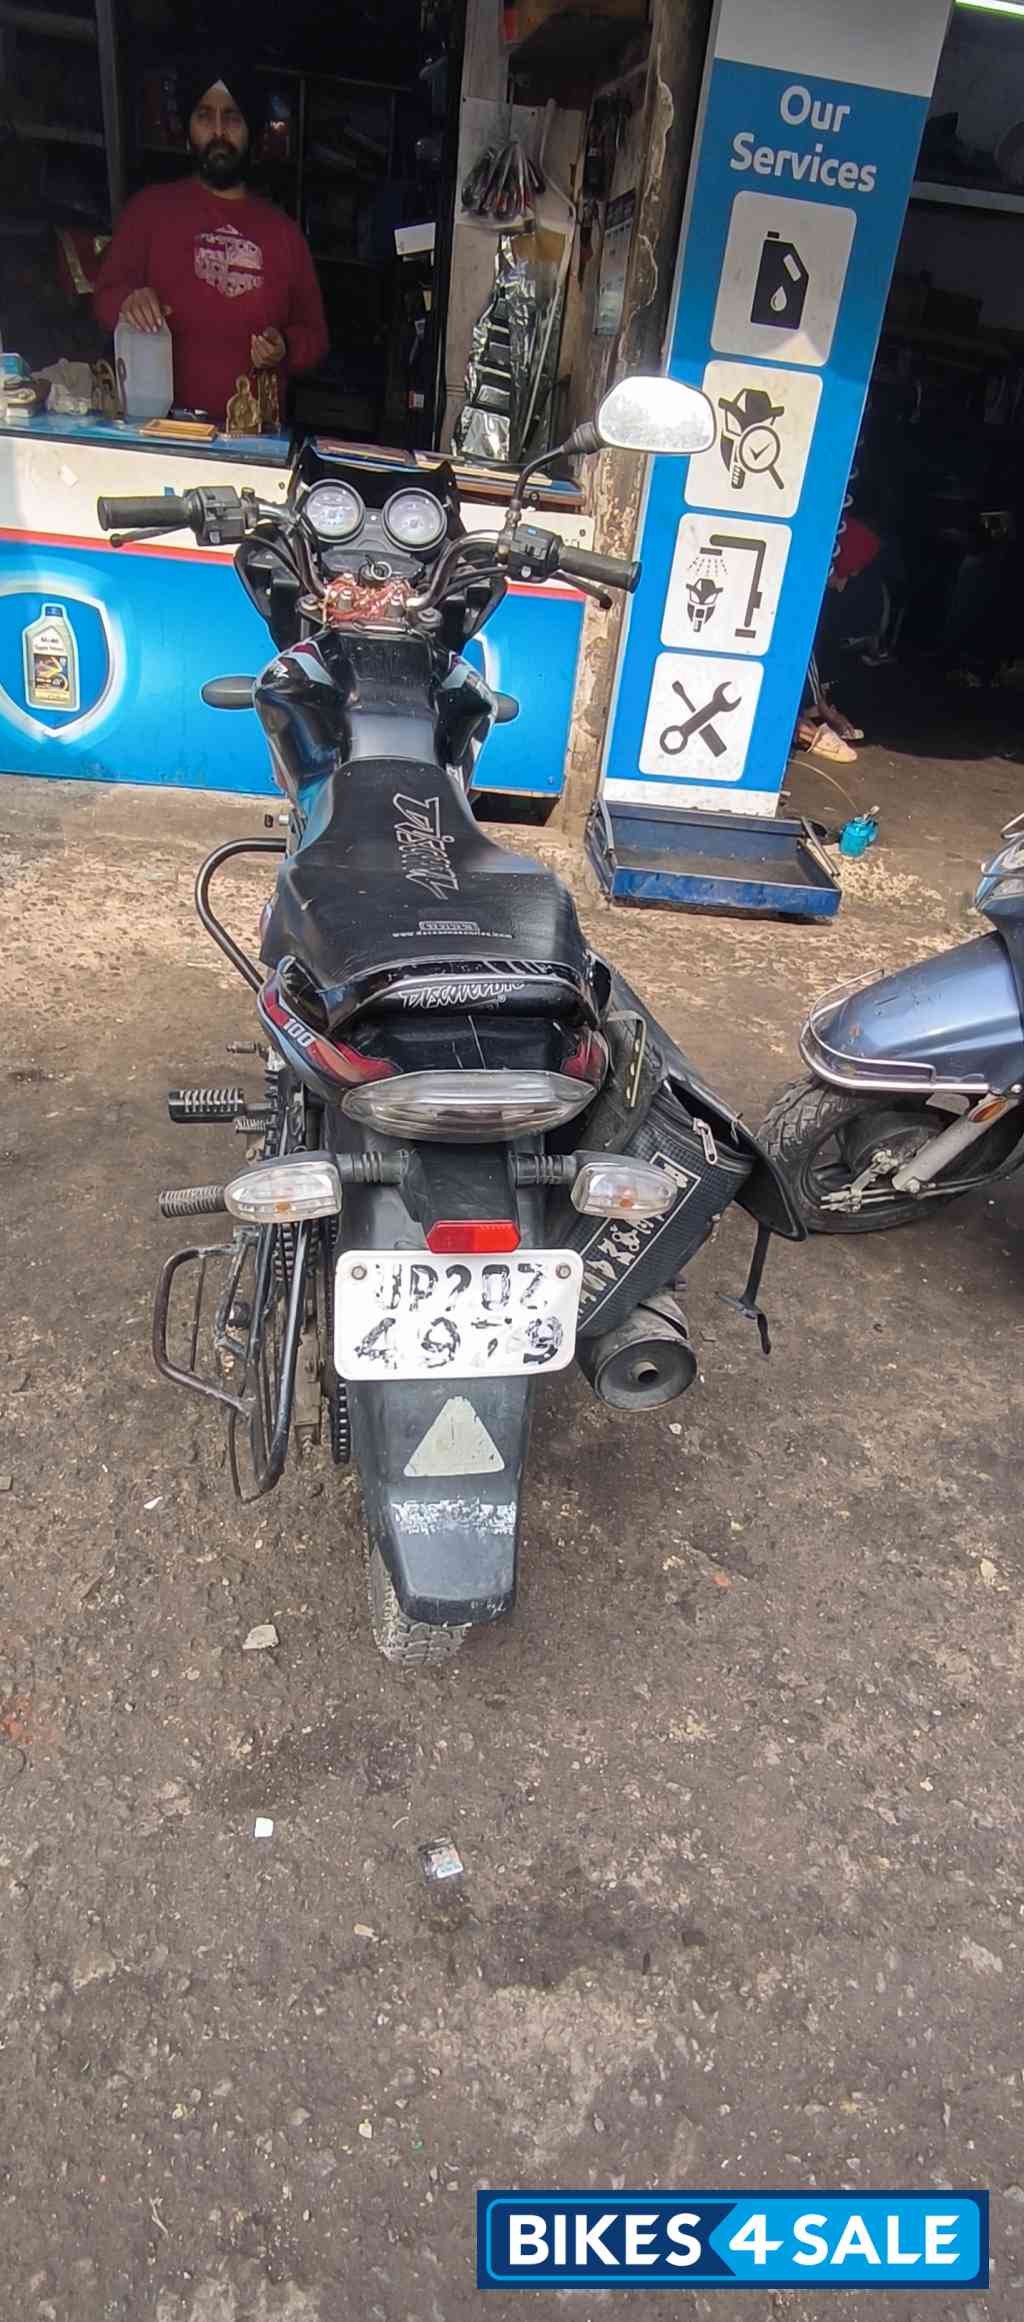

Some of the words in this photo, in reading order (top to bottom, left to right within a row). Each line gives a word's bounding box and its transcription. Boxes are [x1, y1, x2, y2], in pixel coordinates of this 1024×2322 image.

[780, 85, 851, 132] Our
[730, 131, 878, 193] Services
[283, 1018, 317, 1047] 100
